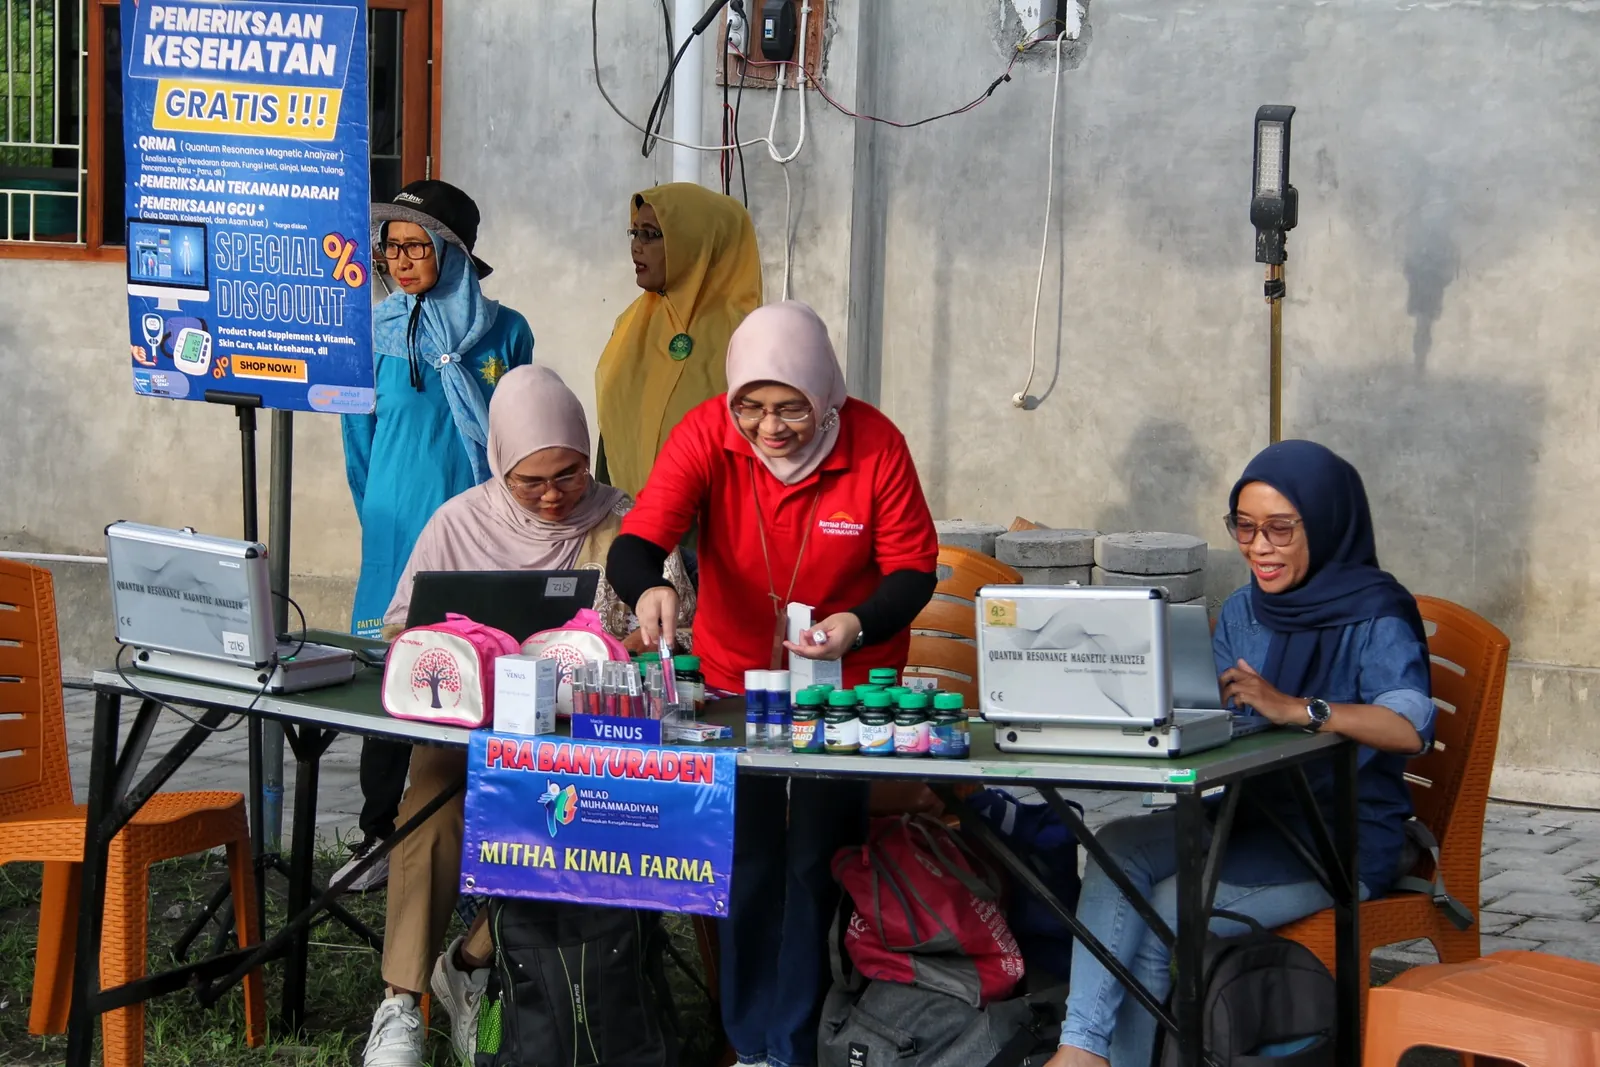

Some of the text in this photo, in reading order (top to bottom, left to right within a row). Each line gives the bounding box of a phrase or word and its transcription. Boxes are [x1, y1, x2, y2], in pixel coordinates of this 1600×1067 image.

[150, 6, 323, 39] PEMERIKSAAN
[143, 34, 336, 76] KESEHATAN
[165, 88, 279, 123] GRATIS
[139, 135, 176, 151] QRMA
[185, 143, 220, 153] Quantum
[221, 145, 264, 156] Resonance
[266, 148, 302, 159] Magnetic
[304, 150, 339, 161] Analyzer
[242, 162, 263, 171] Fungsi
[140, 174, 339, 200] PEMERIKSAAN TEKANAN DARAH
[140, 195, 225, 214] PEMERIKSAAN
[227, 202, 255, 217] GCU
[215, 231, 324, 277] SPECIAL
[216, 278, 346, 327] DISCOUNT
[218, 326, 247, 336] Product
[248, 329, 266, 338] Food
[268, 330, 313, 342] Supplement
[322, 334, 356, 346] Vitamin,
[218, 339, 234, 348] Skin
[236, 340, 255, 351] Care,
[256, 342, 272, 351] Alat
[273, 344, 316, 355] Kesehatan,
[240, 360, 266, 371] SHOP
[267, 363, 292, 373] NOW
[116, 580, 243, 610] QUANTUM RESONANCE MAGNETIC ANALYZER
[989, 650, 1146, 665] QUANTUM RESONANCE MAGNETIC ANALYZER
[593, 724, 643, 740] VENUS
[486, 736, 715, 785] PRA BANYURADEN
[580, 789, 609, 799] MILAD
[580, 800, 659, 814] MUHAMMADIYAH
[479, 841, 715, 884] MITHA KIMIA FARMA
